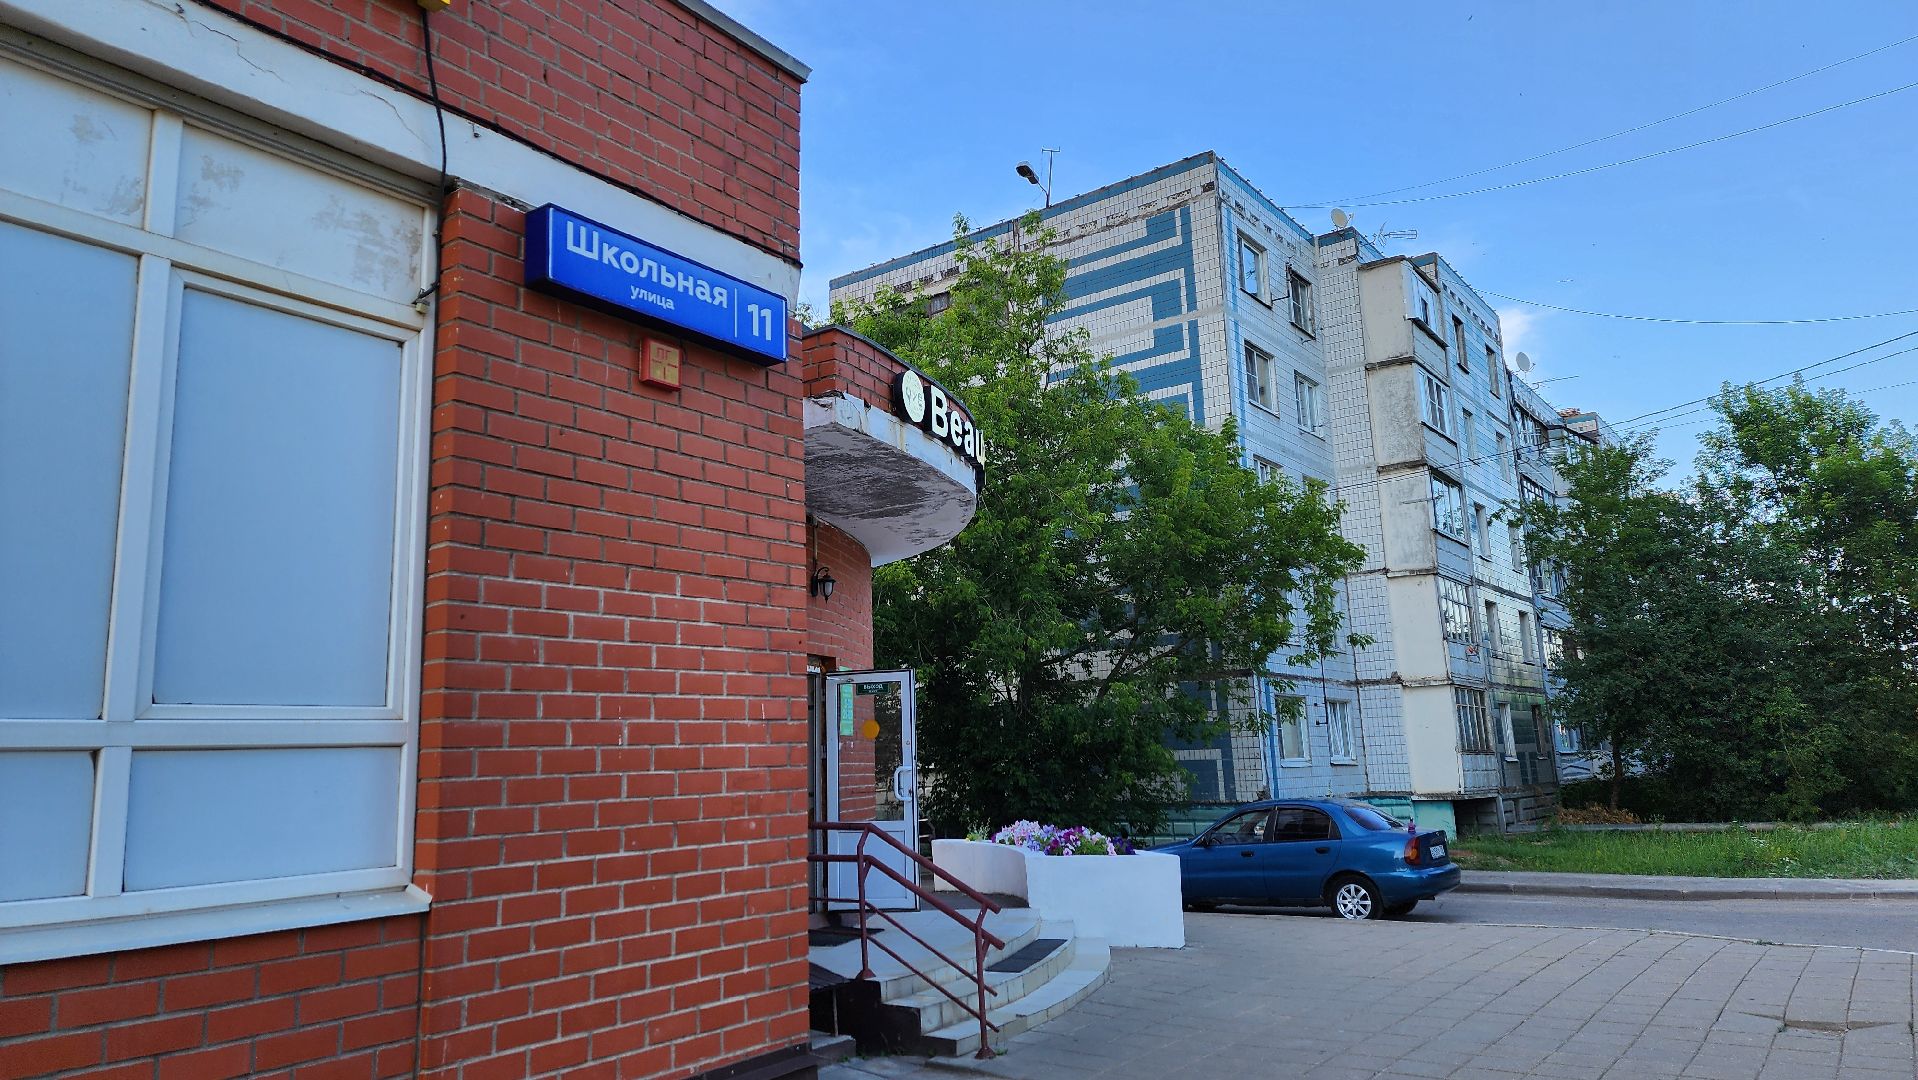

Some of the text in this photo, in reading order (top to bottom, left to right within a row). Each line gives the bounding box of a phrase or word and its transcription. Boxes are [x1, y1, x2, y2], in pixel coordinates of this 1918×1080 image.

[566, 221, 772, 341] Школьная 11
[630, 285, 675, 311] улица
